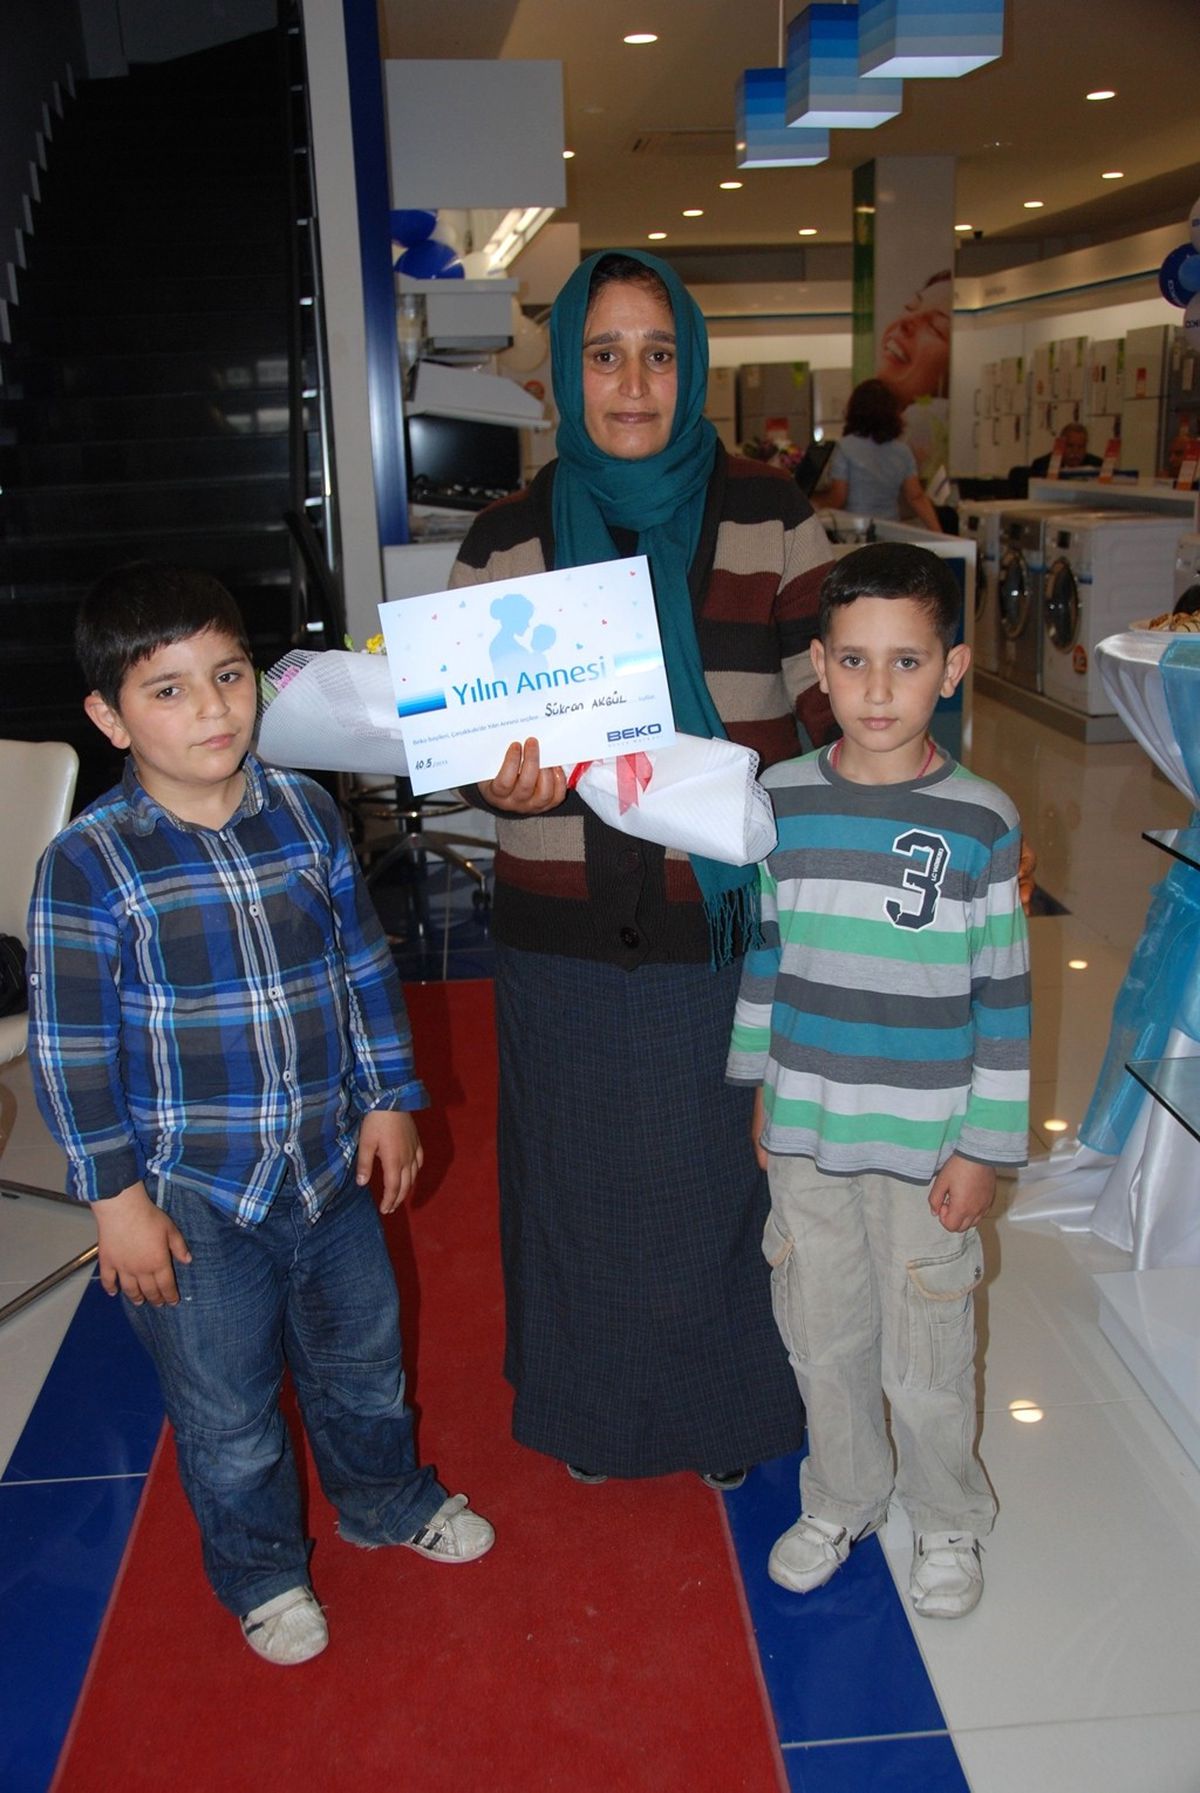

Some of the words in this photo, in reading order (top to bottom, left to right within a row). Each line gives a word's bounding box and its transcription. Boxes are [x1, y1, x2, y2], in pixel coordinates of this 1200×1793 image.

[452, 678, 508, 705] Yılın
[517, 655, 606, 694] Annesi
[606, 723, 662, 742] BEKO
[884, 828, 951, 932] 3
